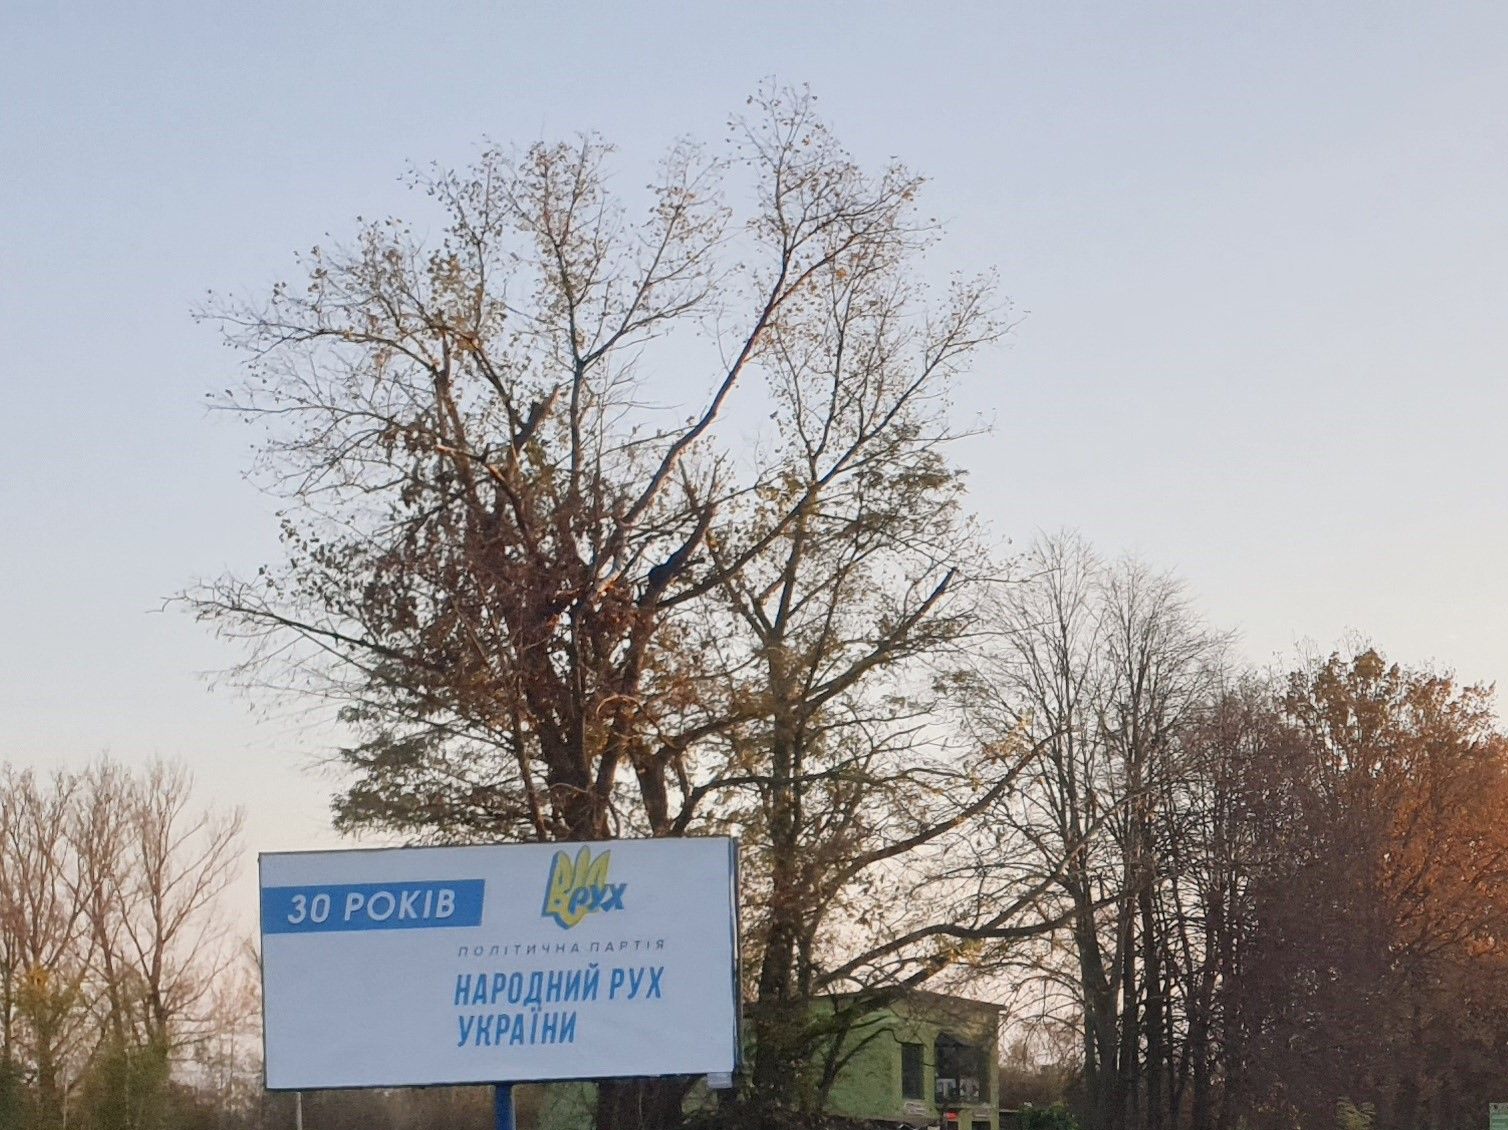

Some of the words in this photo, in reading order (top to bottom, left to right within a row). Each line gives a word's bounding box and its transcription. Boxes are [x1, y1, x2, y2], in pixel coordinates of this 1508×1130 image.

[287, 893, 331, 924] 30
[344, 888, 456, 922] РОКІВ
[457, 943, 580, 957] ПОЛІТИЧНА
[589, 939, 665, 953] ПАРТІЯ
[454, 963, 600, 1006] НАРОДНИЙ
[608, 966, 664, 1000] РУХ
[457, 1006, 577, 1047] УКРАЇНИ
